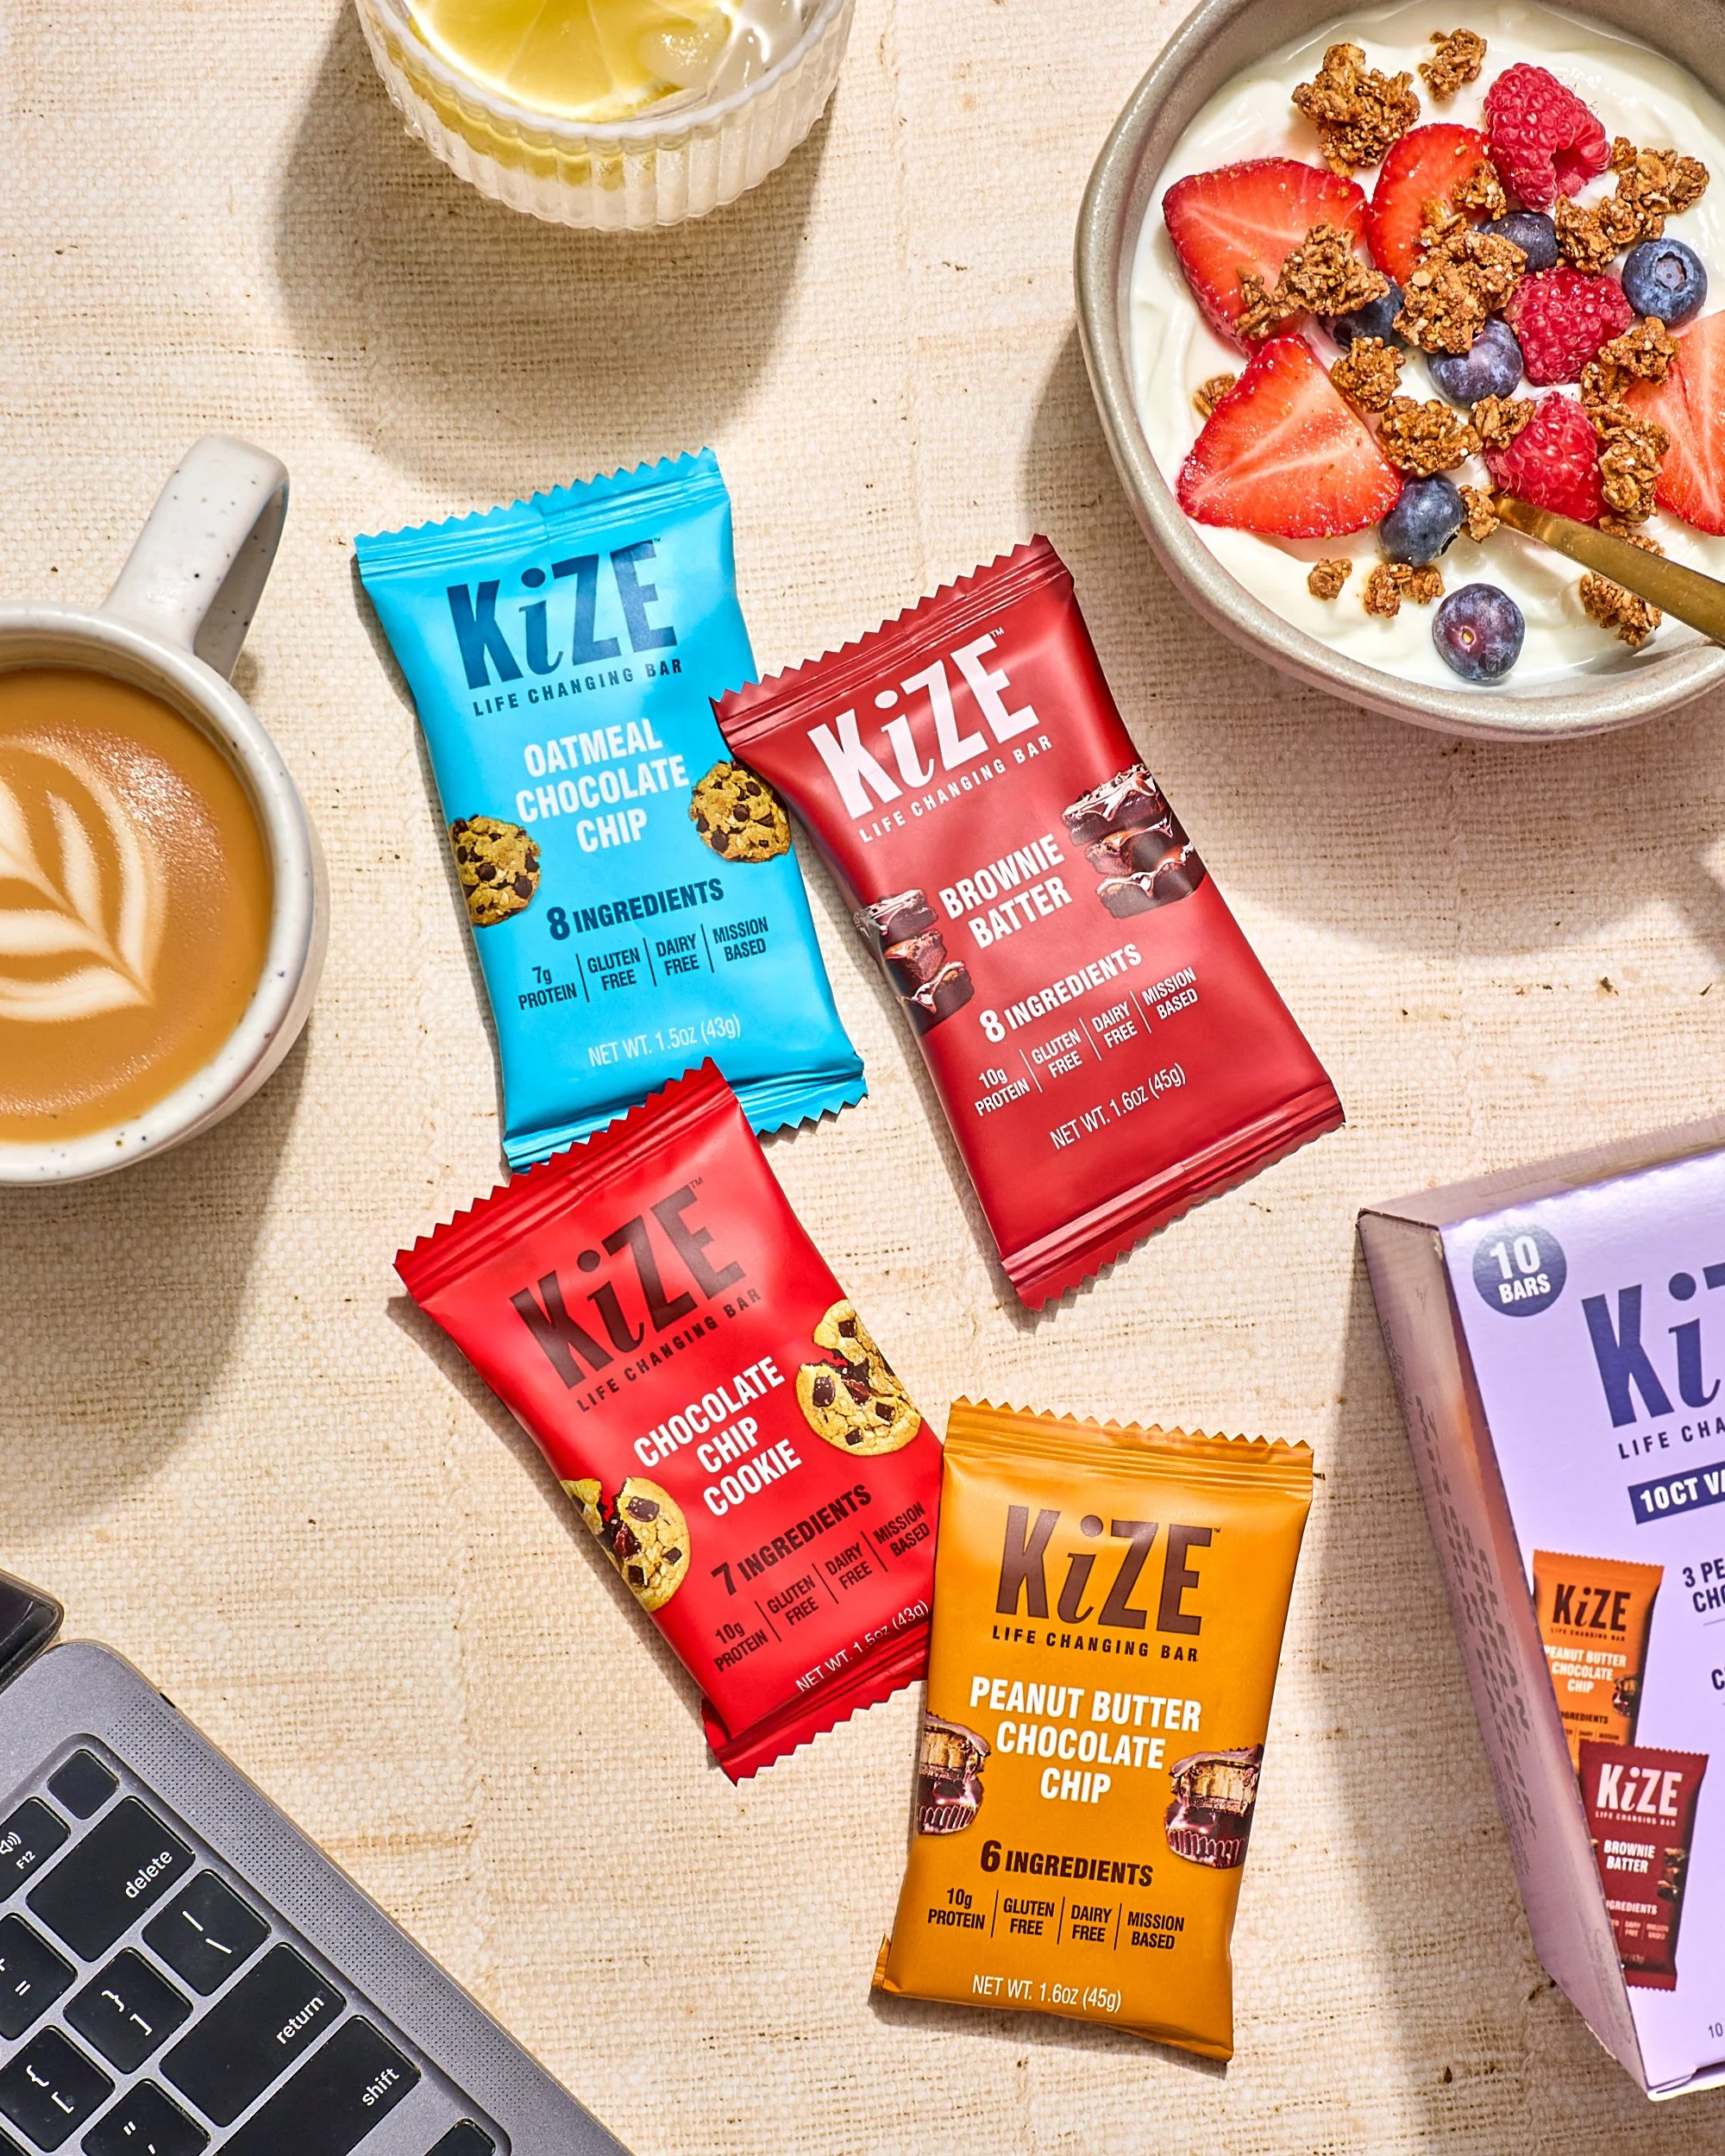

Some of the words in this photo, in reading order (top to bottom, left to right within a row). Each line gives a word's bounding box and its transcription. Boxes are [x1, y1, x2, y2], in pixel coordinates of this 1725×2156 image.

[447, 538, 676, 688] KiZE
[473, 693, 518, 717] LIFE
[528, 668, 633, 704] CHANGING
[646, 659, 682, 679] BAR
[807, 633, 1039, 820] KiZE
[524, 718, 662, 776] OATMEAL
[516, 755, 689, 823] CHOCOLATE
[859, 811, 905, 843] LIFE
[911, 759, 1005, 816] CHANGING
[1013, 736, 1051, 763] BAR
[576, 808, 647, 852] CHIP
[939, 833, 1064, 918] BROWNIE
[547, 906, 570, 940] 8
[573, 878, 724, 933] INGREDIENTS
[969, 877, 1072, 948] BATTER
[656, 933, 695, 957] DAIRY
[712, 916, 768, 943] MISSION
[587, 947, 640, 973] GLUTEN
[663, 954, 699, 975] FREE
[724, 937, 766, 962] BASED
[531, 966, 552, 985] 7g
[600, 969, 637, 991] FREE
[980, 1010, 1005, 1042] 8
[1004, 943, 1141, 1029] INGREDIENTS
[1142, 967, 1196, 1005] MISSION
[518, 982, 577, 1010] PROTEIN
[1156, 988, 1197, 1019] BASED
[1091, 1001, 1130, 1032] DAIRY
[1103, 1020, 1138, 1048] FREE
[588, 1041, 618, 1066] NET
[622, 1034, 651, 1058] WT.
[655, 1026, 698, 1050] 1.5oz
[700, 1013, 740, 1044] (43g)
[1032, 1029, 1081, 1063] GLUTEN
[979, 1069, 1007, 1088] 10g
[1048, 1050, 1082, 1077] FREE
[975, 1077, 1030, 1116] PROTEIN
[1050, 1119, 1080, 1149] NET
[1079, 1106, 1110, 1131] WT.
[1109, 1086, 1149, 1117] 1.6oz
[1148, 1062, 1185, 1099] (45g)
[1490, 1235, 1541, 1281] 10
[510, 1185, 745, 1388] KiZE
[1498, 1272, 1552, 1303] BARS
[577, 1378, 619, 1412] LIFE
[624, 1316, 718, 1381] CHANGING
[722, 1288, 762, 1322] BAR
[1582, 1263, 1725, 1428] Ki
[634, 1357, 785, 1467] CHOCOLATE
[697, 1417, 757, 1472] CHIP
[1618, 1432, 1670, 1459] LIFE
[703, 1438, 801, 1515] COOKIE
[1640, 1476, 1698, 1514] 10CT
[711, 1562, 737, 1595] 7
[737, 1484, 871, 1581] INGREDIENTS
[873, 1501, 925, 1544] MISSION
[889, 1522, 930, 1557] BASED
[825, 1542, 862, 1575] DAIRY
[838, 1560, 872, 1589] FREE
[995, 1505, 1212, 1636] KiZE
[767, 1575, 815, 1614] GLUTEN
[1683, 1566, 1696, 1588] 3
[785, 1596, 819, 1626] FREE
[1552, 1583, 1631, 1633] KiZE
[713, 1629, 768, 1672] PROTEIN
[715, 1622, 745, 1644] 10g
[795, 1665, 824, 1691] NET
[824, 1649, 853, 1670] WT.
[892, 1600, 929, 1630] (43g)
[993, 1625, 1035, 1644] LIFE
[1046, 1633, 1148, 1657] CHANGING
[1161, 1645, 1197, 1662] BAR
[1552, 1661, 1614, 1682] CHOCOLATE
[1586, 1650, 1627, 1668] BUTTER
[969, 1676, 1084, 1718] PEANUT
[1091, 1690, 1201, 1732] BUTTER
[1567, 1678, 1594, 1694] CHIP
[996, 1720, 1165, 1769] CHOCOLATE
[1040, 1767, 1111, 1803] CHIP
[1596, 1763, 1683, 1816] KiZE
[16, 1851, 35, 1869] F12
[981, 1839, 1001, 1872] 6
[1005, 1850, 1153, 1886] INGREDIENTS
[1603, 1839, 1656, 1859] BROWNIE
[1607, 1855, 1648, 1874] BATTER
[125, 1852, 172, 1898] delete
[947, 1888, 972, 1909] 10g
[1003, 1897, 1055, 1917] GLUTEN
[1070, 1904, 1112, 1923] DAIRY
[927, 1908, 985, 1929] PROTEIN
[1010, 1918, 1044, 1935] FREE
[1071, 1924, 1106, 1942] FREE
[1127, 1911, 1184, 1932] MISSION
[1131, 1931, 1175, 1949] BASED
[972, 1974, 1003, 1996] NET
[1007, 1978, 1032, 1999] WT.
[1040, 1982, 1078, 2004] 1.6oz
[1082, 1987, 1120, 2012] (45g)
[276, 1997, 324, 2044] return
[1708, 2022, 1723, 2039] 10
[362, 2069, 399, 2105] shift
